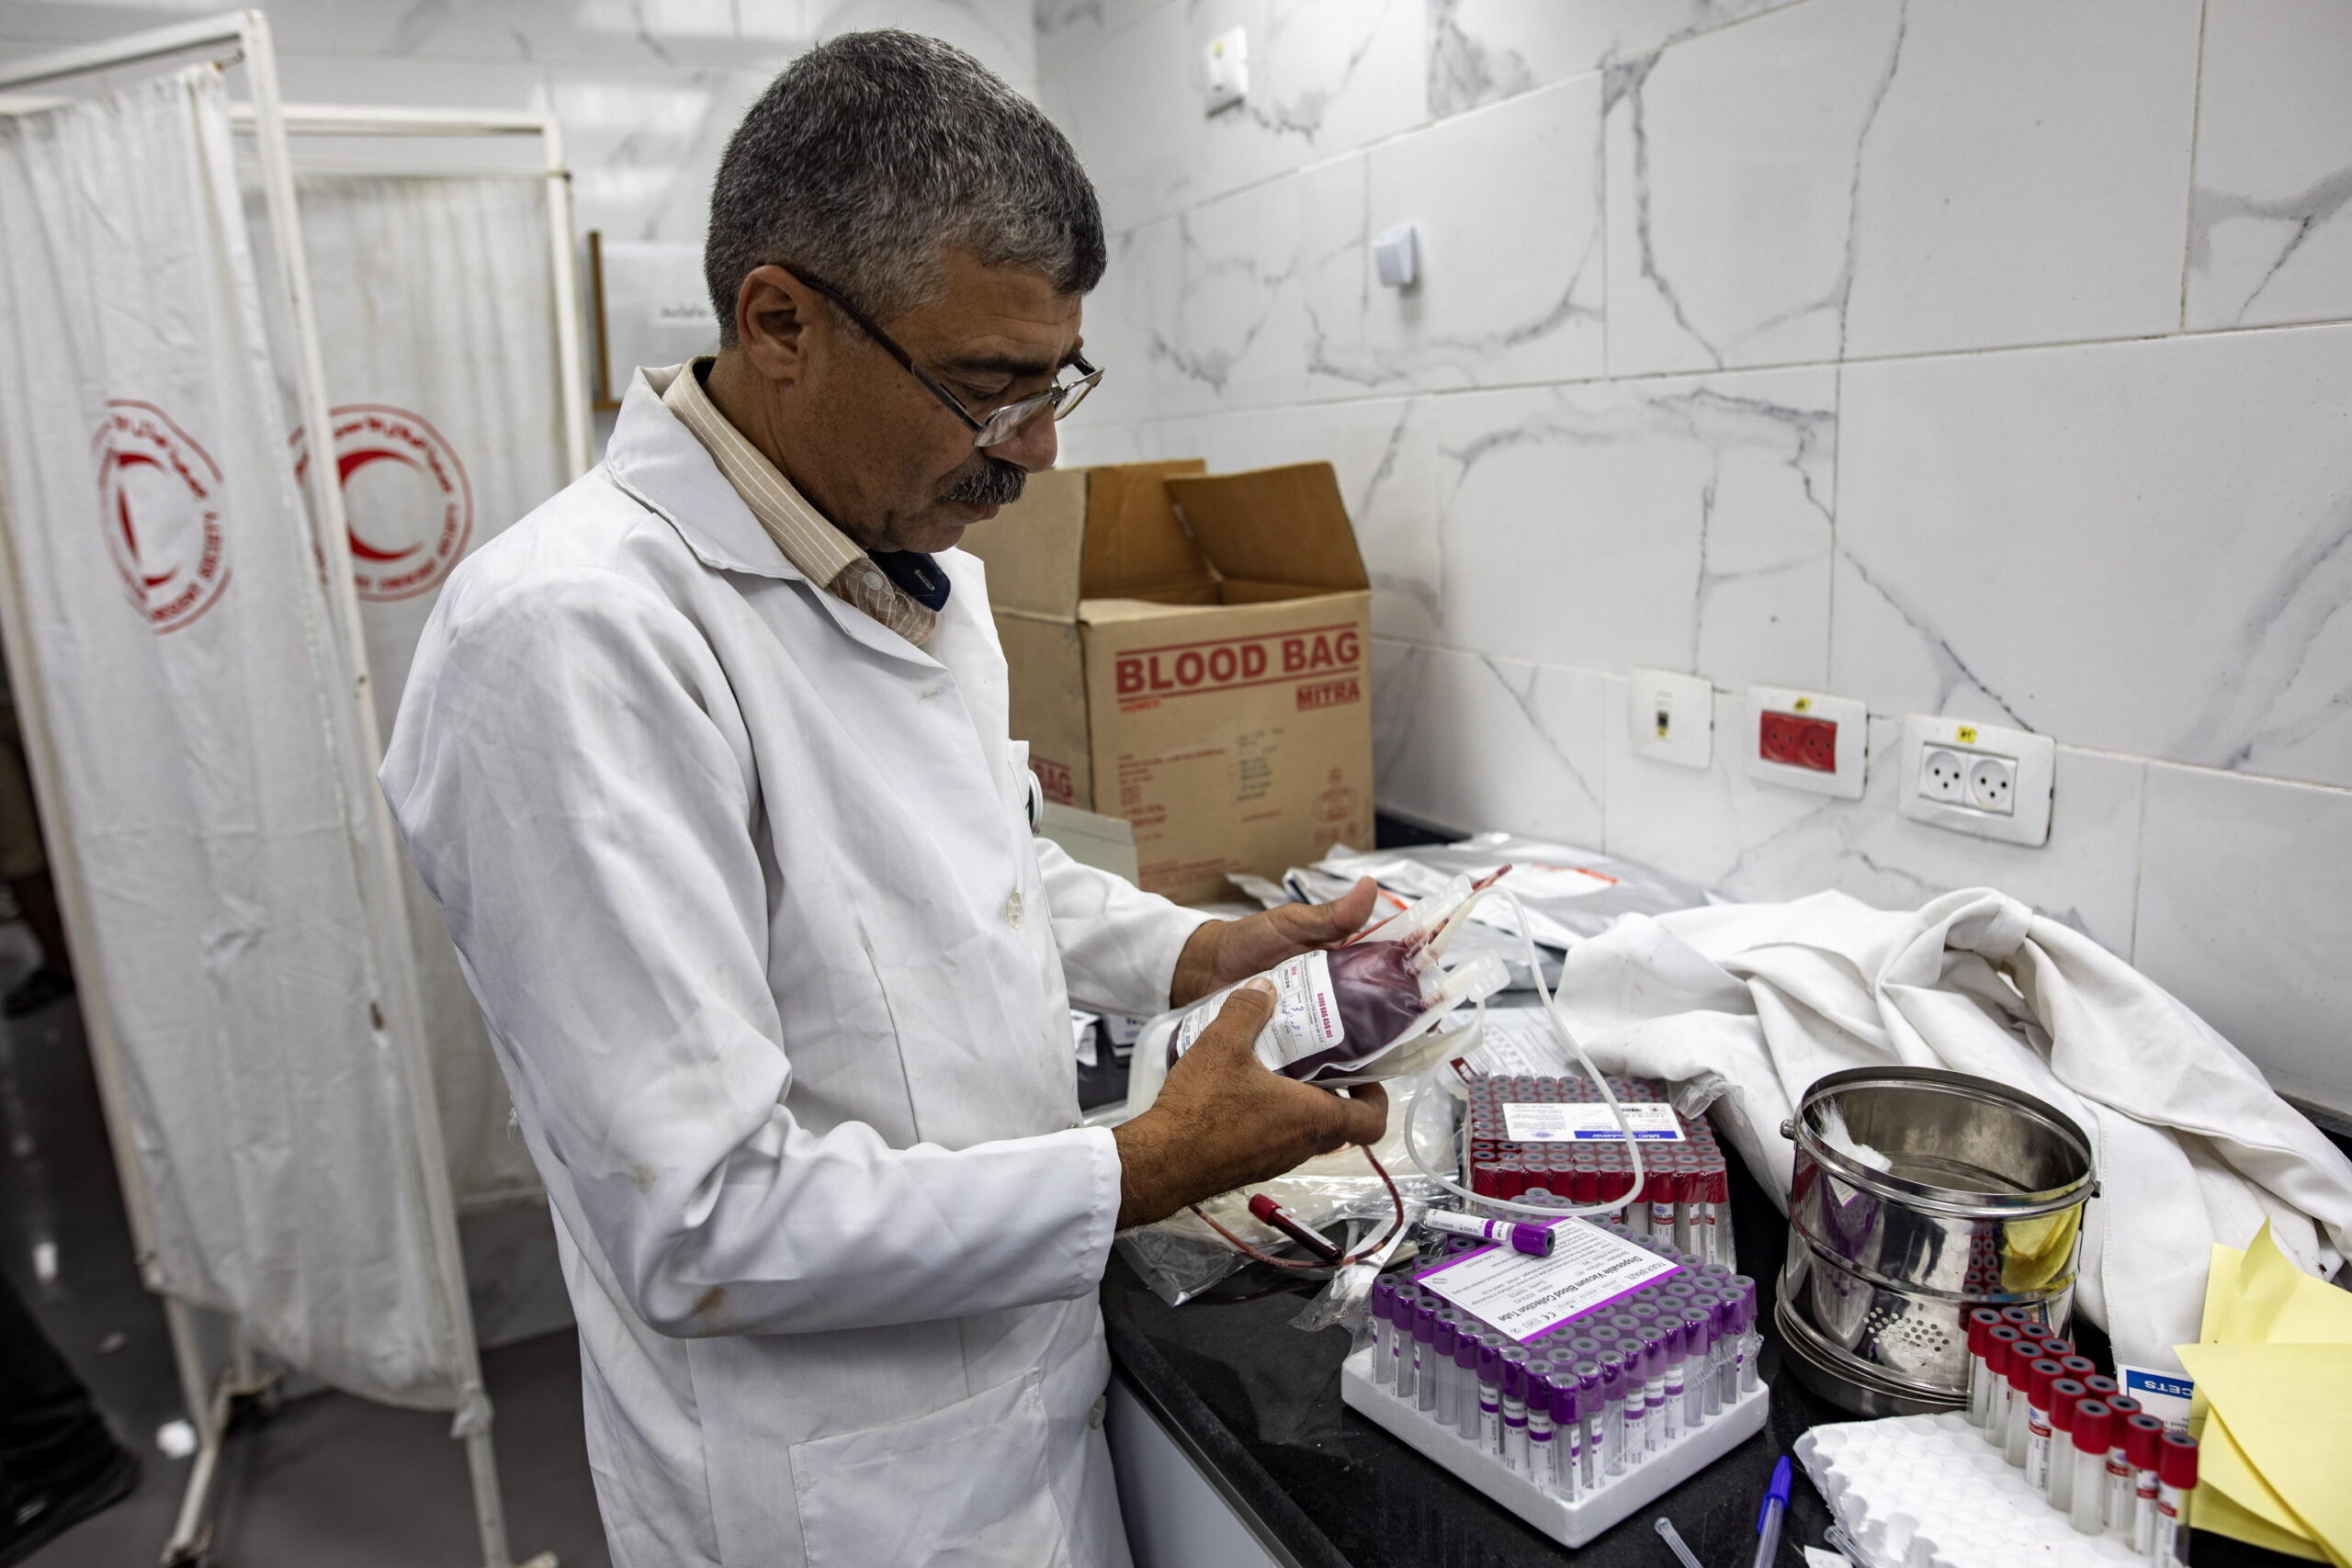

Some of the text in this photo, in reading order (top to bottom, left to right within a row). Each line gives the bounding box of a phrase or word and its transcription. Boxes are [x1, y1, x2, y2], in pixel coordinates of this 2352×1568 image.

[1115, 631, 1360, 695] BLOOD BAG
[1296, 679, 1360, 710] MITRA
[1321, 1016, 1331, 1031] 450
[1496, 1255, 1645, 1323] Disposable Vacuum Blood Collection Tube
